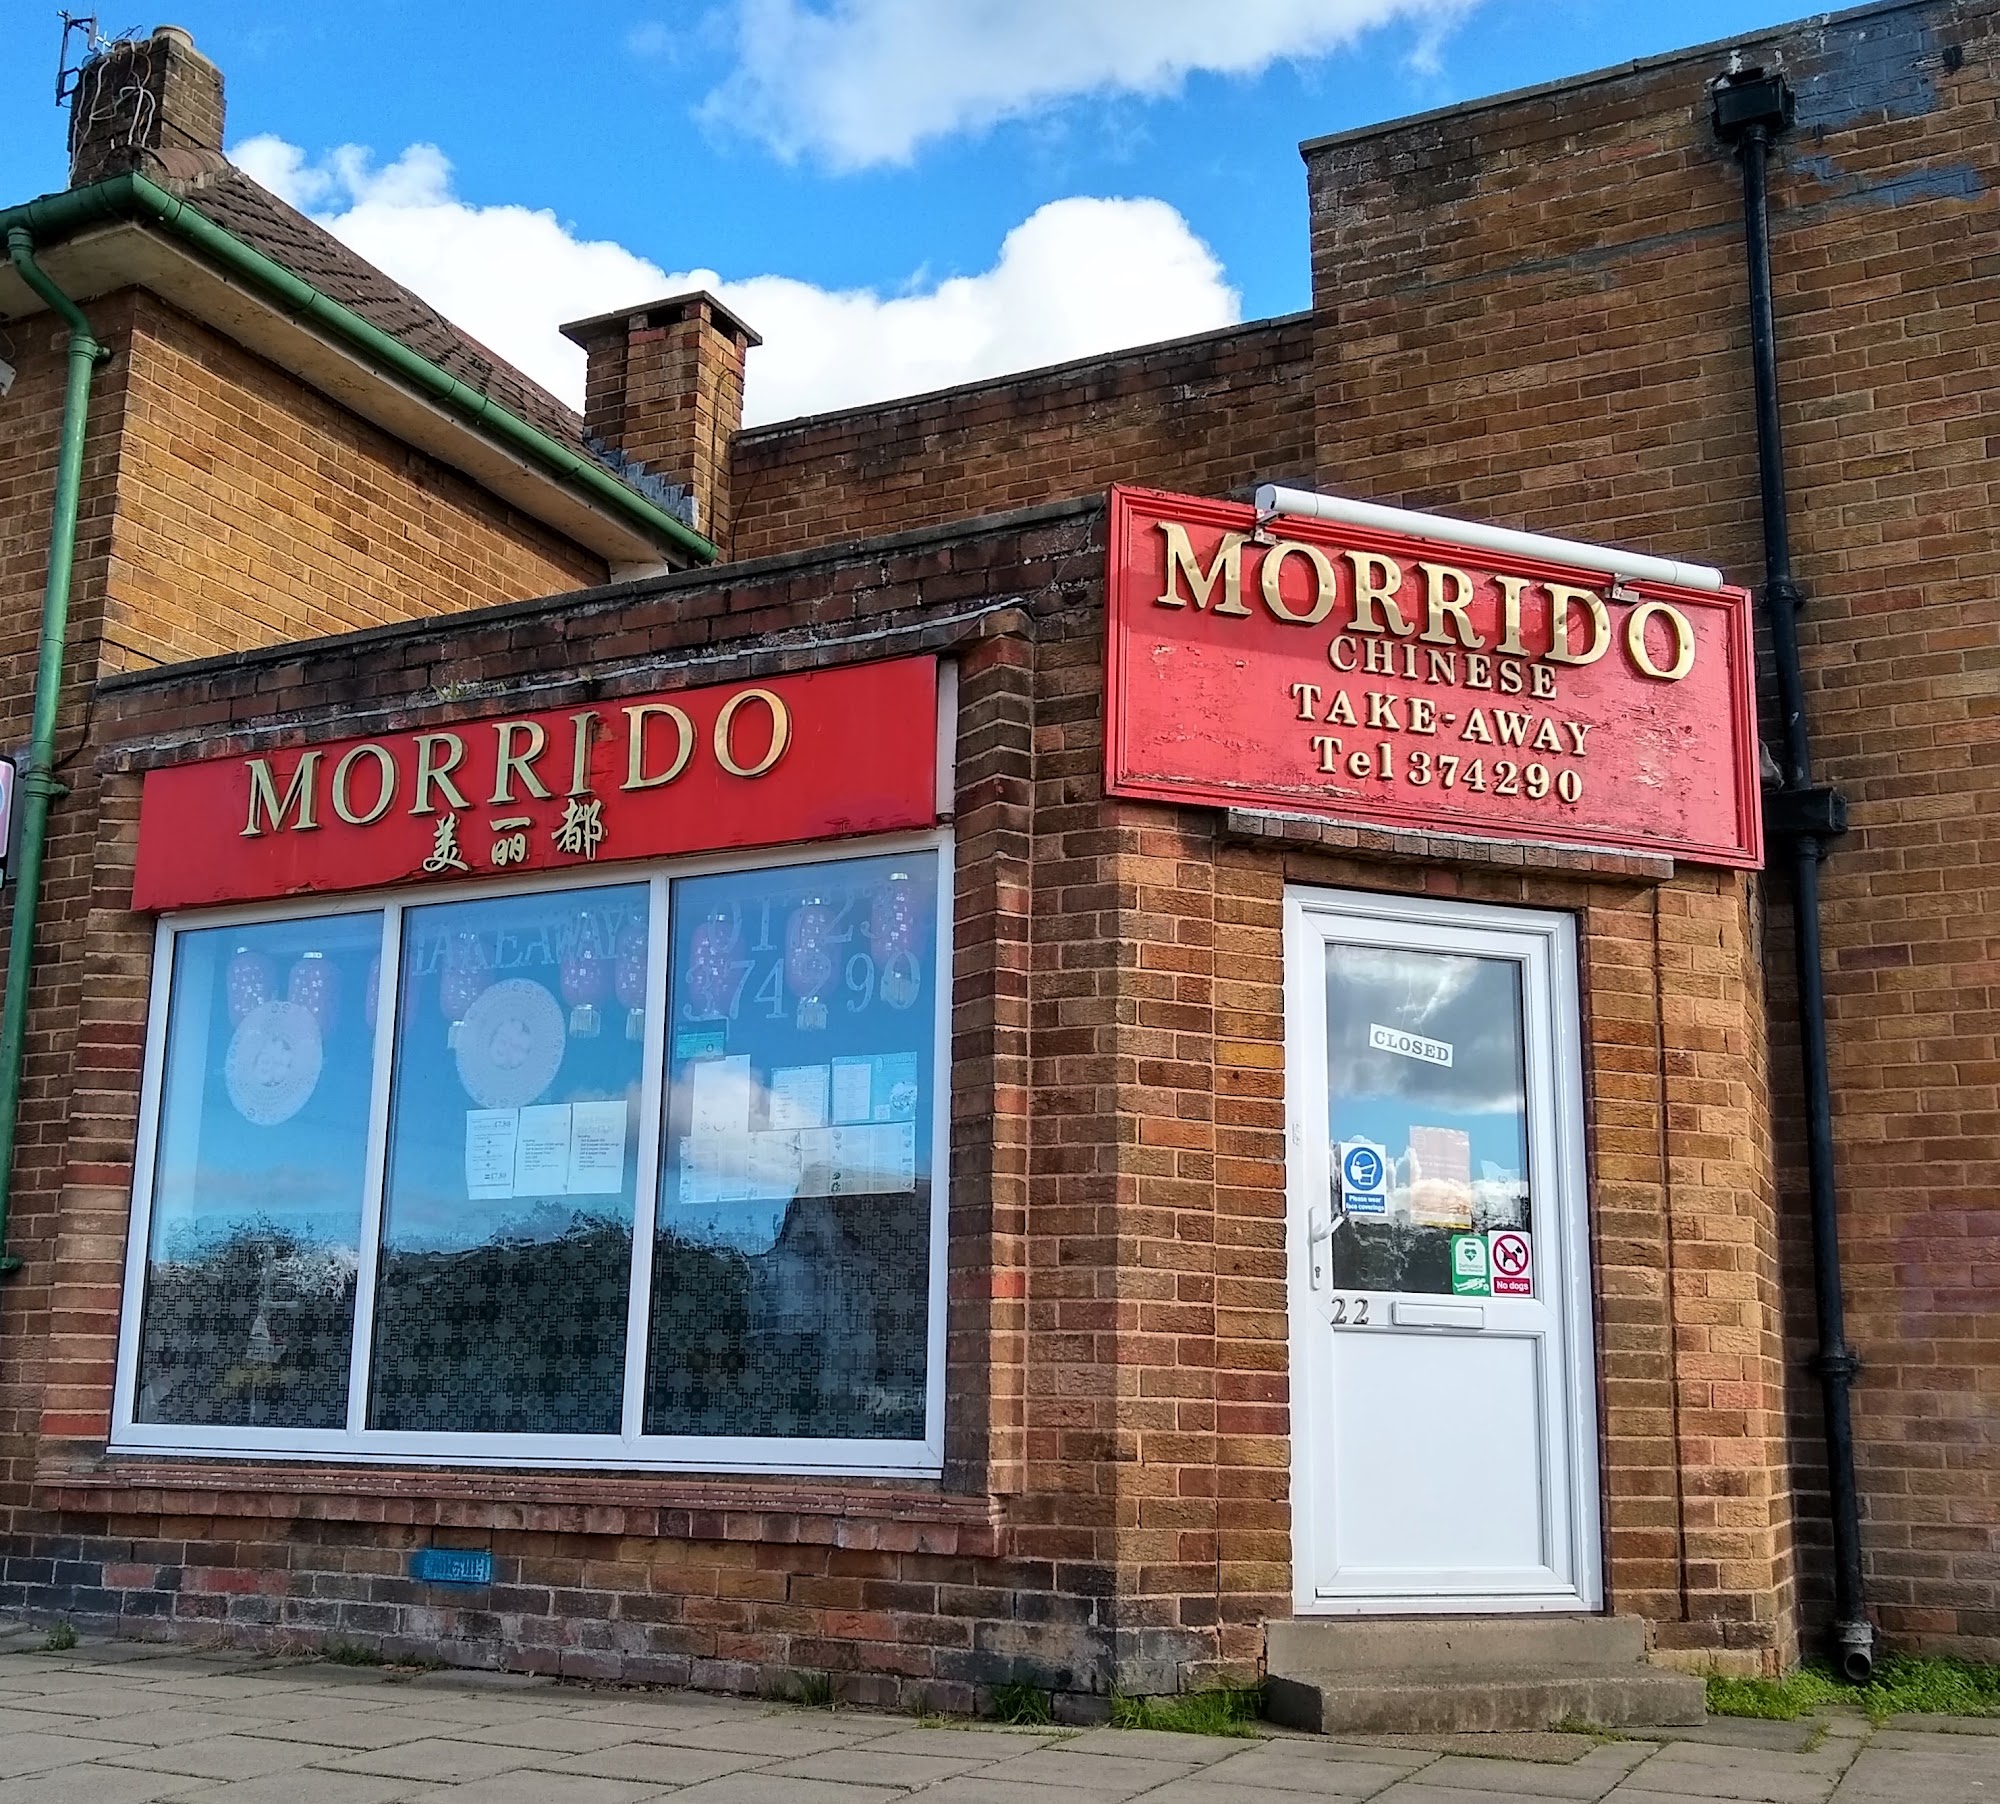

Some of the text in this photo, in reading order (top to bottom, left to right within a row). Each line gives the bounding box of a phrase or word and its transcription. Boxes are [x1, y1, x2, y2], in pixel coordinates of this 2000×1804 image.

[1154, 520, 1696, 681] MORRIDO
[1328, 634, 1558, 700] CHINESE
[1291, 682, 1594, 758] TAKE-AWAY
[239, 687, 794, 838] MORRIDO
[1310, 734, 1583, 804] Tel 374290
[421, 797, 607, 873] 美丽都
[1373, 1030, 1450, 1063] CLOSED
[1348, 1194, 1367, 1203] Please
[1358, 1204, 1385, 1212] coverings
[1331, 1296, 1369, 1325] 22
[1496, 1280, 1529, 1292] No dogs
